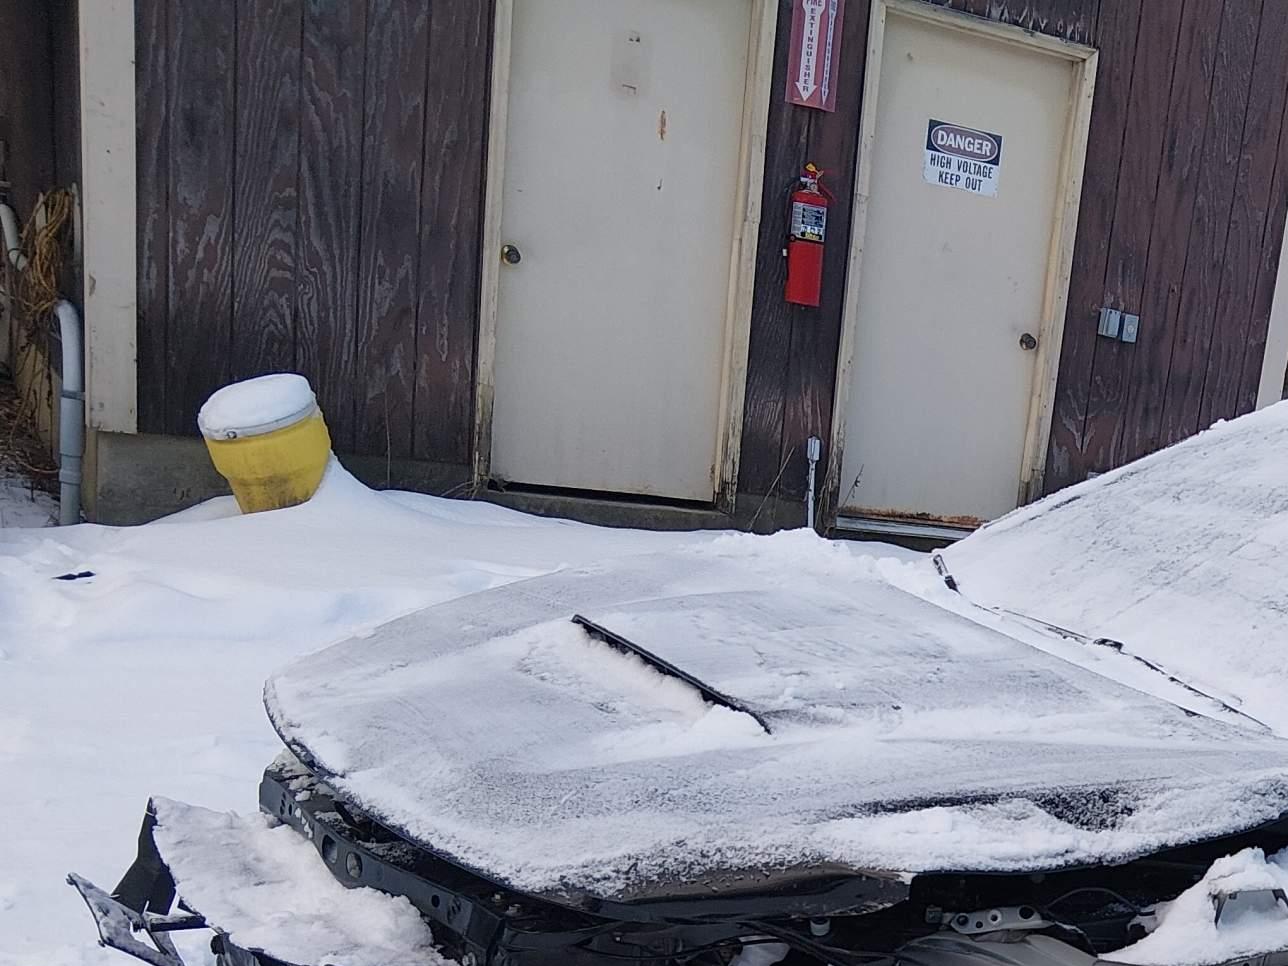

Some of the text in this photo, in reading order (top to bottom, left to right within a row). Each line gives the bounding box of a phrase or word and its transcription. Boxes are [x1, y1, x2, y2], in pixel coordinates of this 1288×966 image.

[803, 8, 817, 92] EXTINGUISHER
[937, 130, 992, 156] DANGER
[930, 153, 994, 179] HIGH VOLTAGE
[938, 171, 983, 192] KEEP OUT
